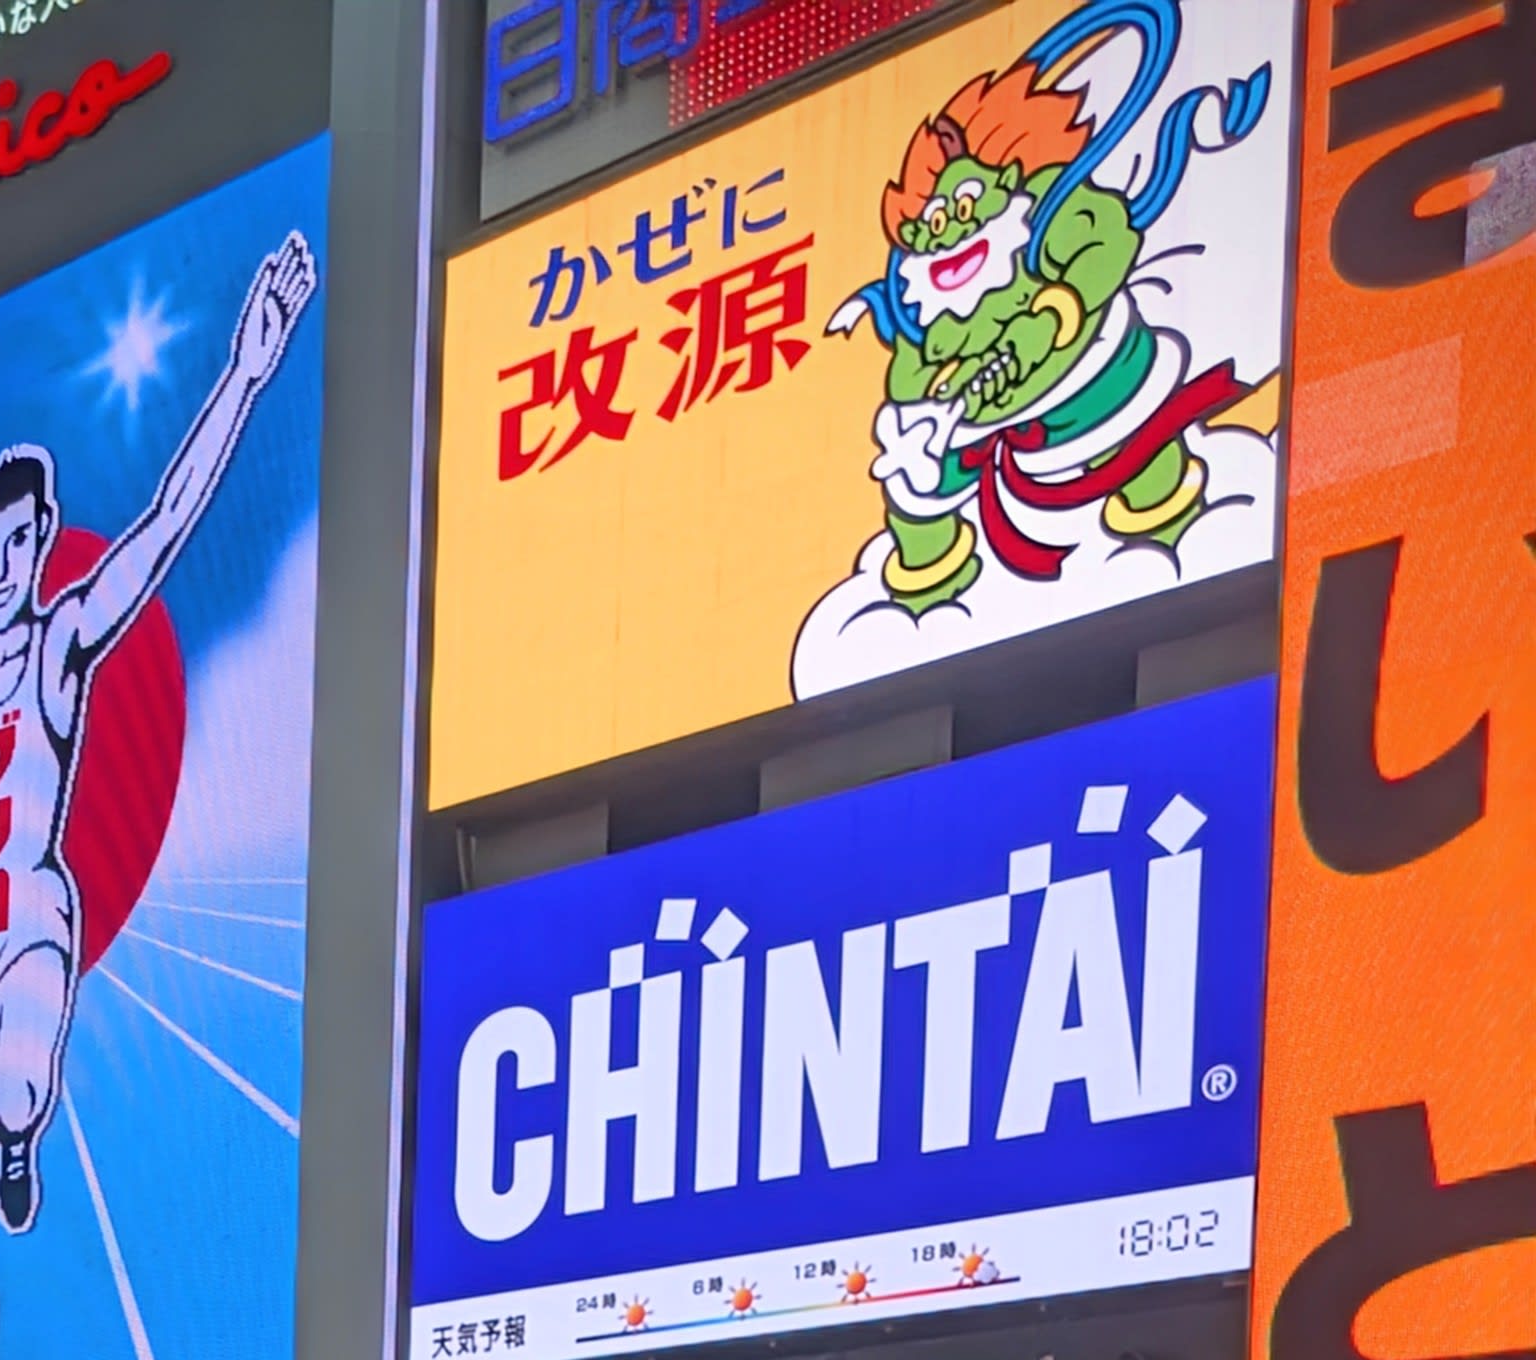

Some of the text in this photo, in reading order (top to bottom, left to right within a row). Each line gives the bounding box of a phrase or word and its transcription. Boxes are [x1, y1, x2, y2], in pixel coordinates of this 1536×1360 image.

[528, 168, 788, 327] かぜに
[498, 232, 814, 482] 改源
[1119, 1207, 1221, 1259] 18:02
[575, 1239, 958, 1315] 24時 6時 12時 18時
[431, 1314, 527, 1360] 天気予報
